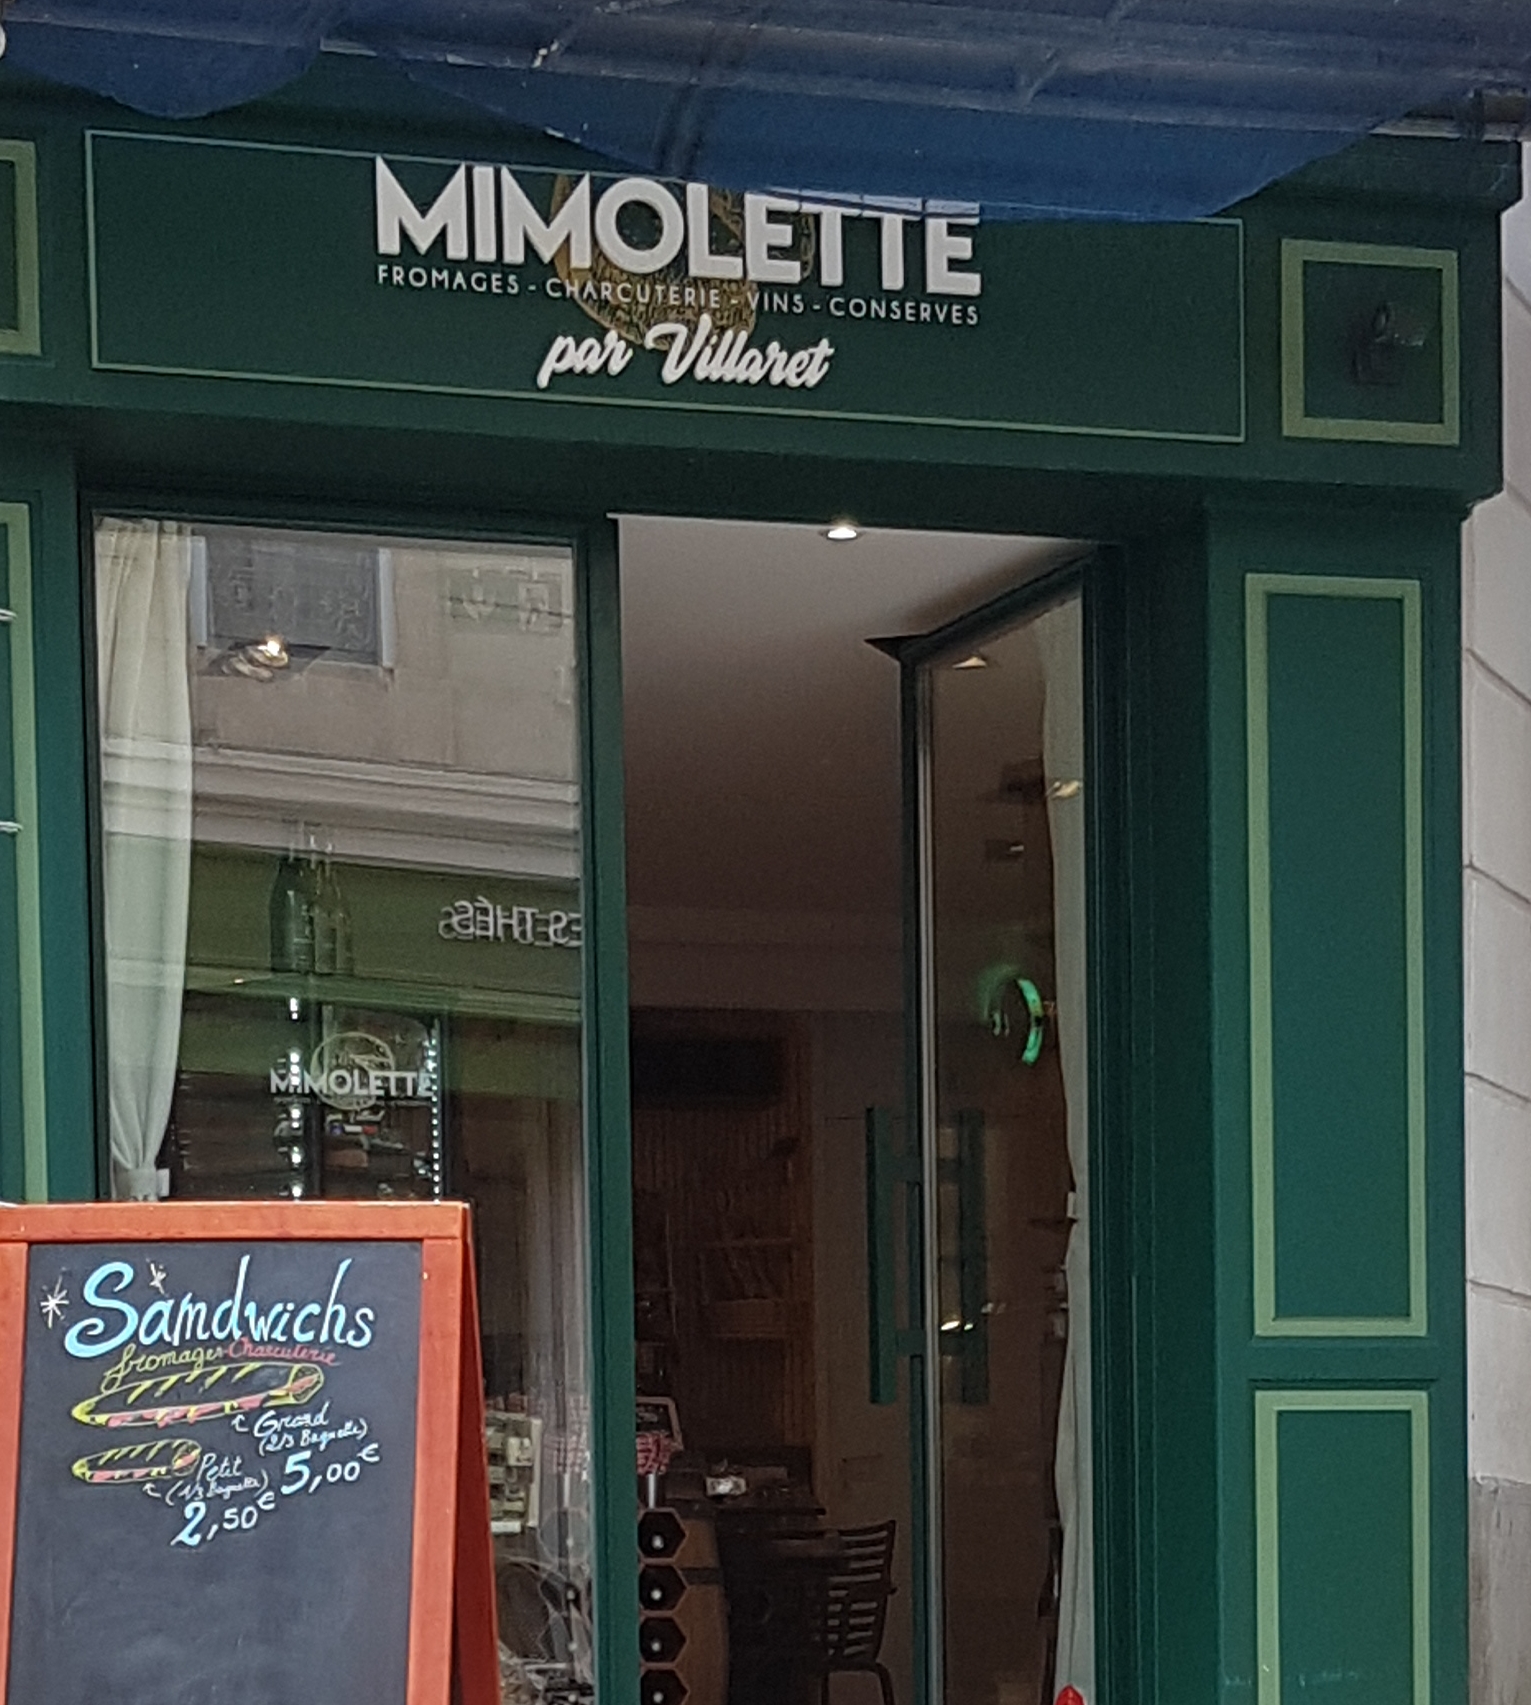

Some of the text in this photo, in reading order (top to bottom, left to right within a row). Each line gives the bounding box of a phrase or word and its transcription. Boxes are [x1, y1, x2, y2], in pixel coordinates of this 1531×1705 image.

[375, 154, 982, 297] MIMOLETTE
[377, 263, 520, 296] FROMAGES
[545, 276, 721, 309] CHARCUTERIE
[747, 290, 805, 315] VINS
[828, 295, 979, 326] CONSERVES
[536, 312, 836, 389] par Villaret
[63, 1254, 375, 1358] Sandwichs
[253, 1402, 330, 1437] Grand
[196, 1452, 243, 1482] Petit
